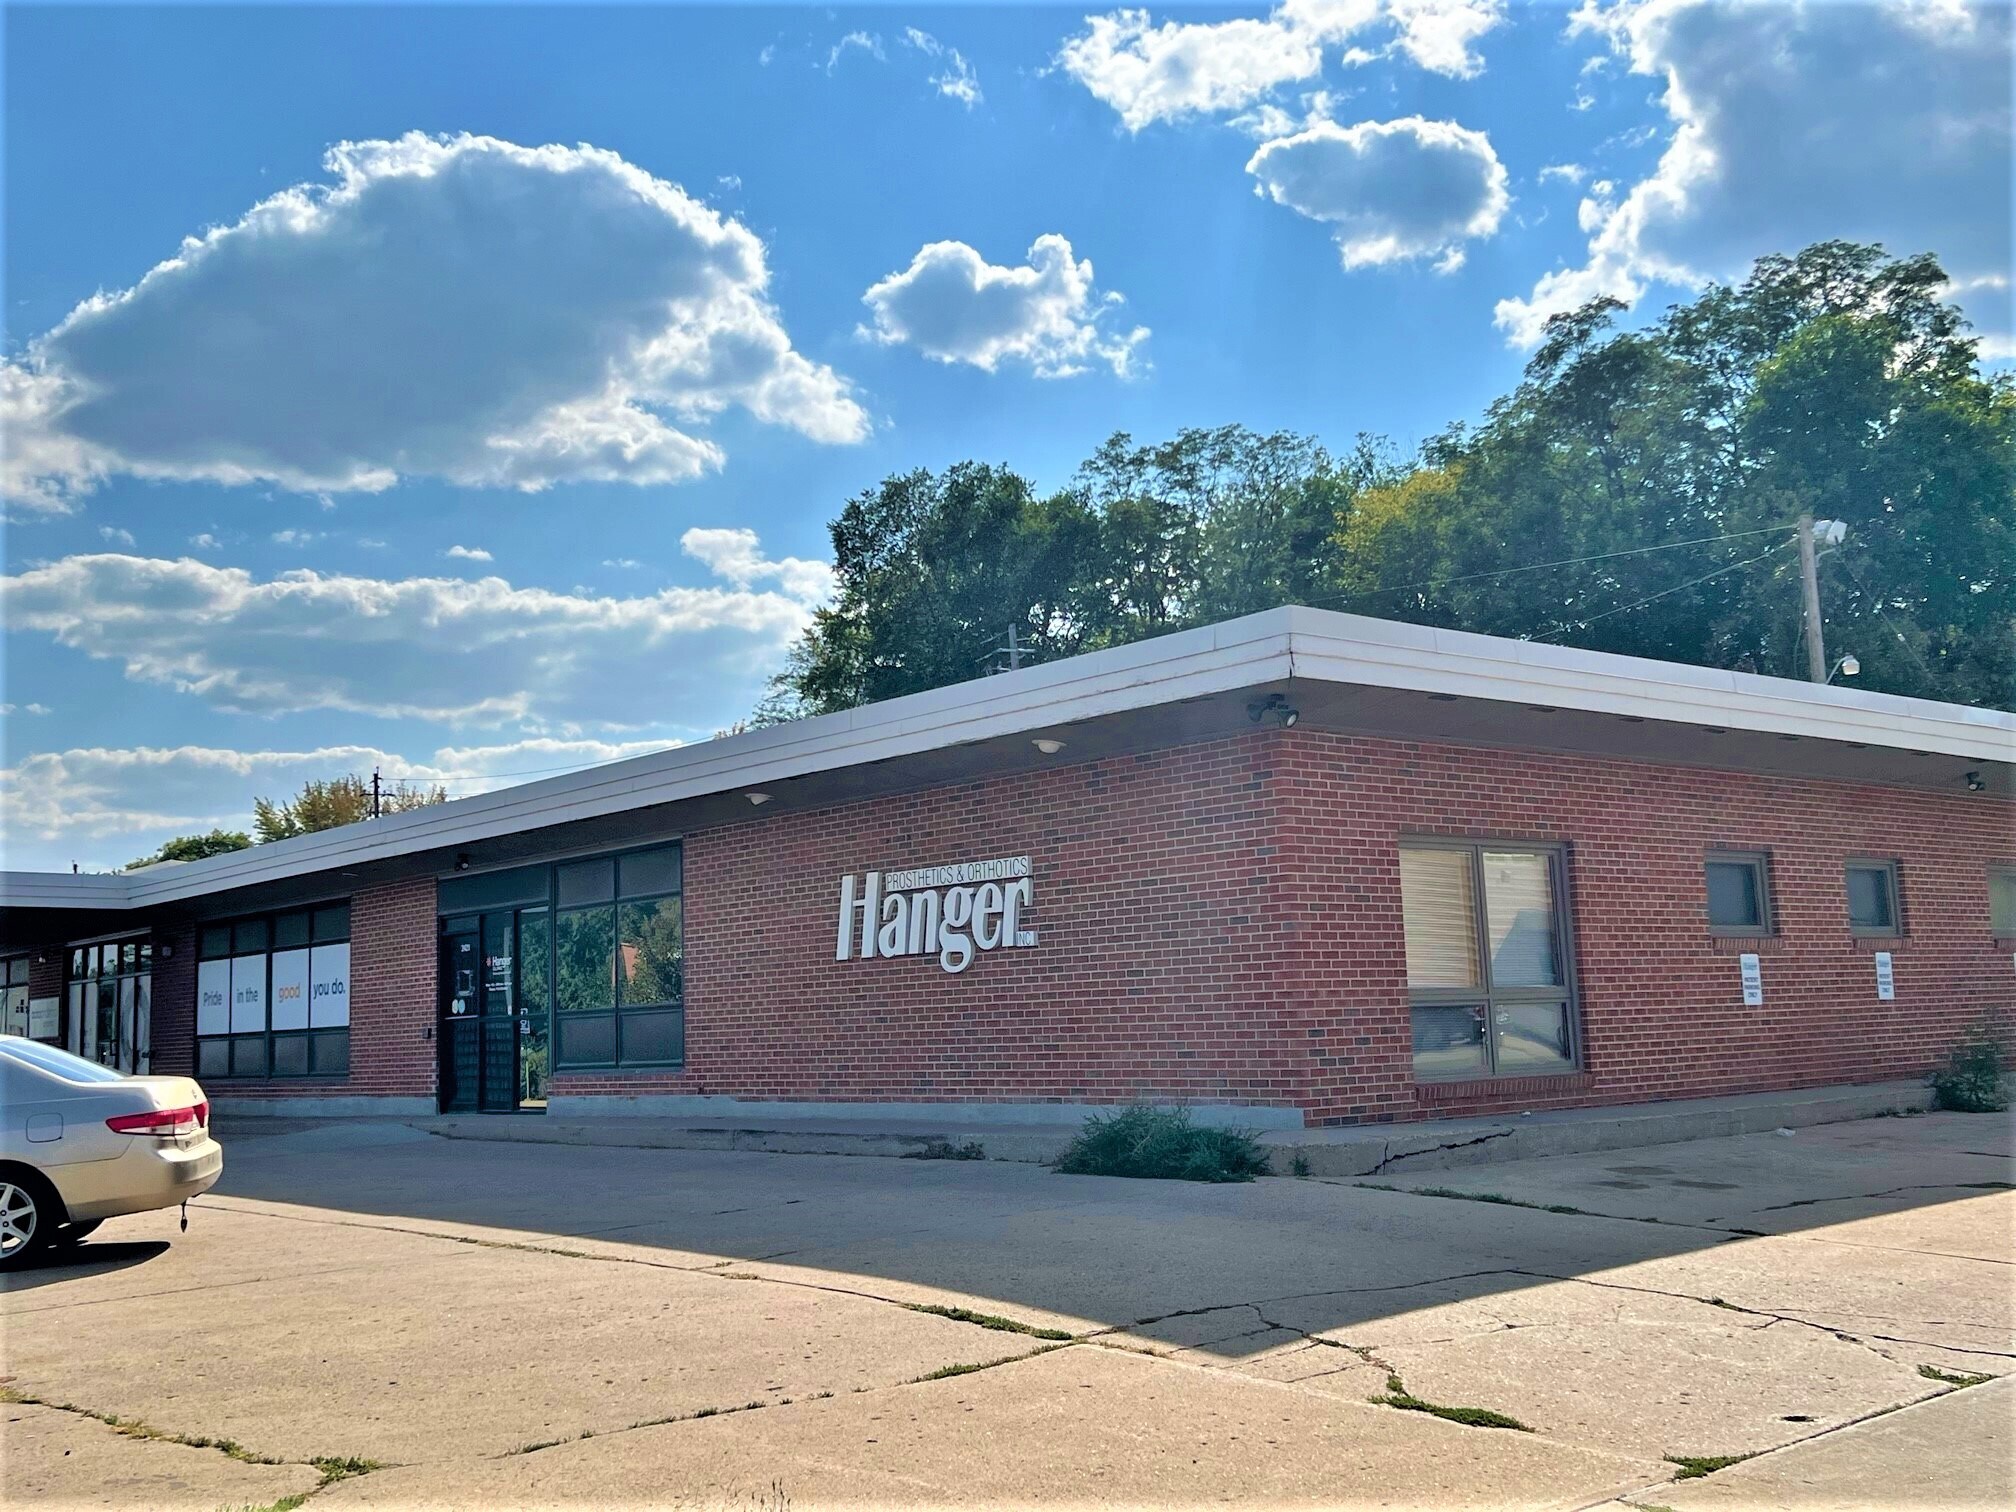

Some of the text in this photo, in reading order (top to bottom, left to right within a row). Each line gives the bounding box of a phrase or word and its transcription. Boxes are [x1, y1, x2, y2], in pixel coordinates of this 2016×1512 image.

[886, 857, 1028, 890] PROSTHETICS & ORTHOTICS
[836, 871, 1034, 974] Hanger
[203, 977, 346, 1007] Pride in the good you do.
